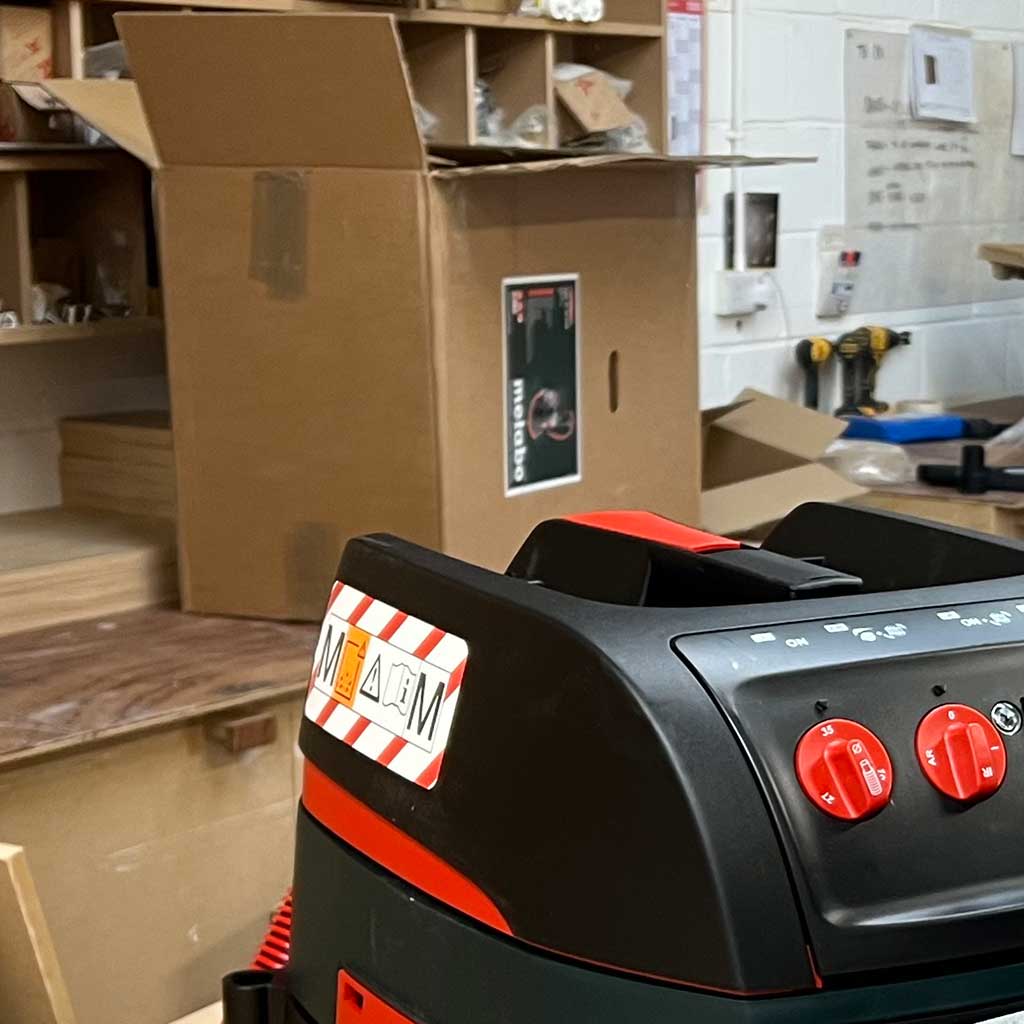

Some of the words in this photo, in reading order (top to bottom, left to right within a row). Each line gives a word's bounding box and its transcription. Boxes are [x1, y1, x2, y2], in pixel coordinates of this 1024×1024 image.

[512, 378, 527, 482] metabo
[785, 636, 809, 648] ON
[317, 624, 345, 687] M
[407, 672, 445, 741] M
[820, 725, 834, 736] 35
